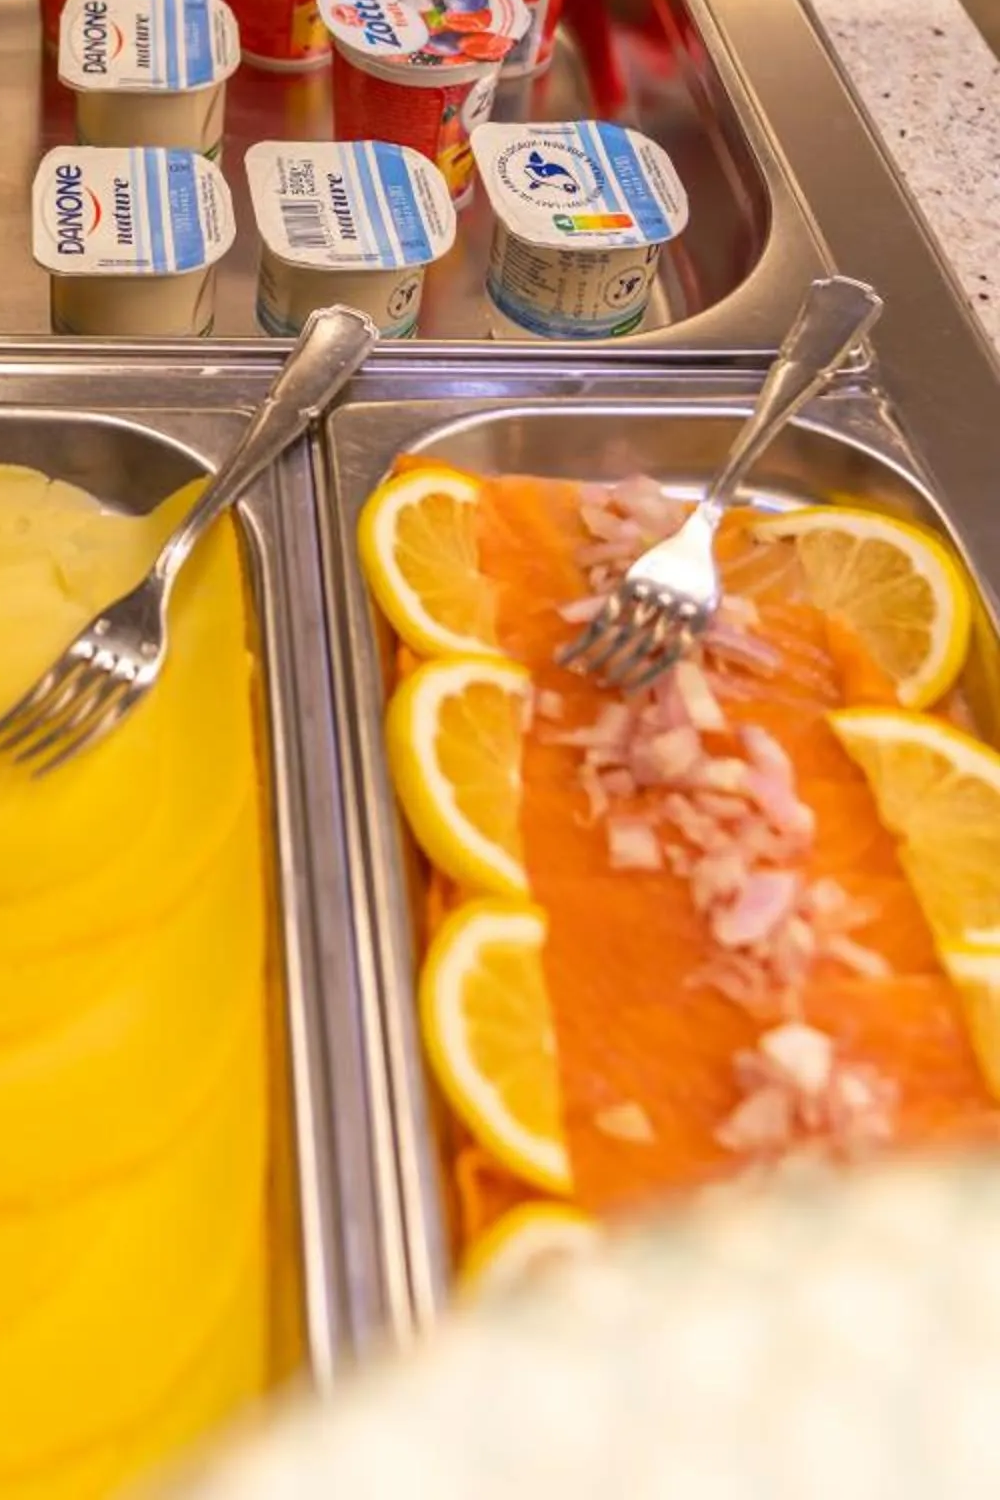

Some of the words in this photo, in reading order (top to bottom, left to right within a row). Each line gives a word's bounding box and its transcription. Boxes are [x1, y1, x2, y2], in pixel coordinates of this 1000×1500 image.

[82, 0, 108, 75] DANONE
[55, 163, 85, 255] DANONE
[112, 177, 133, 245] nature
[327, 172, 358, 241] nature
